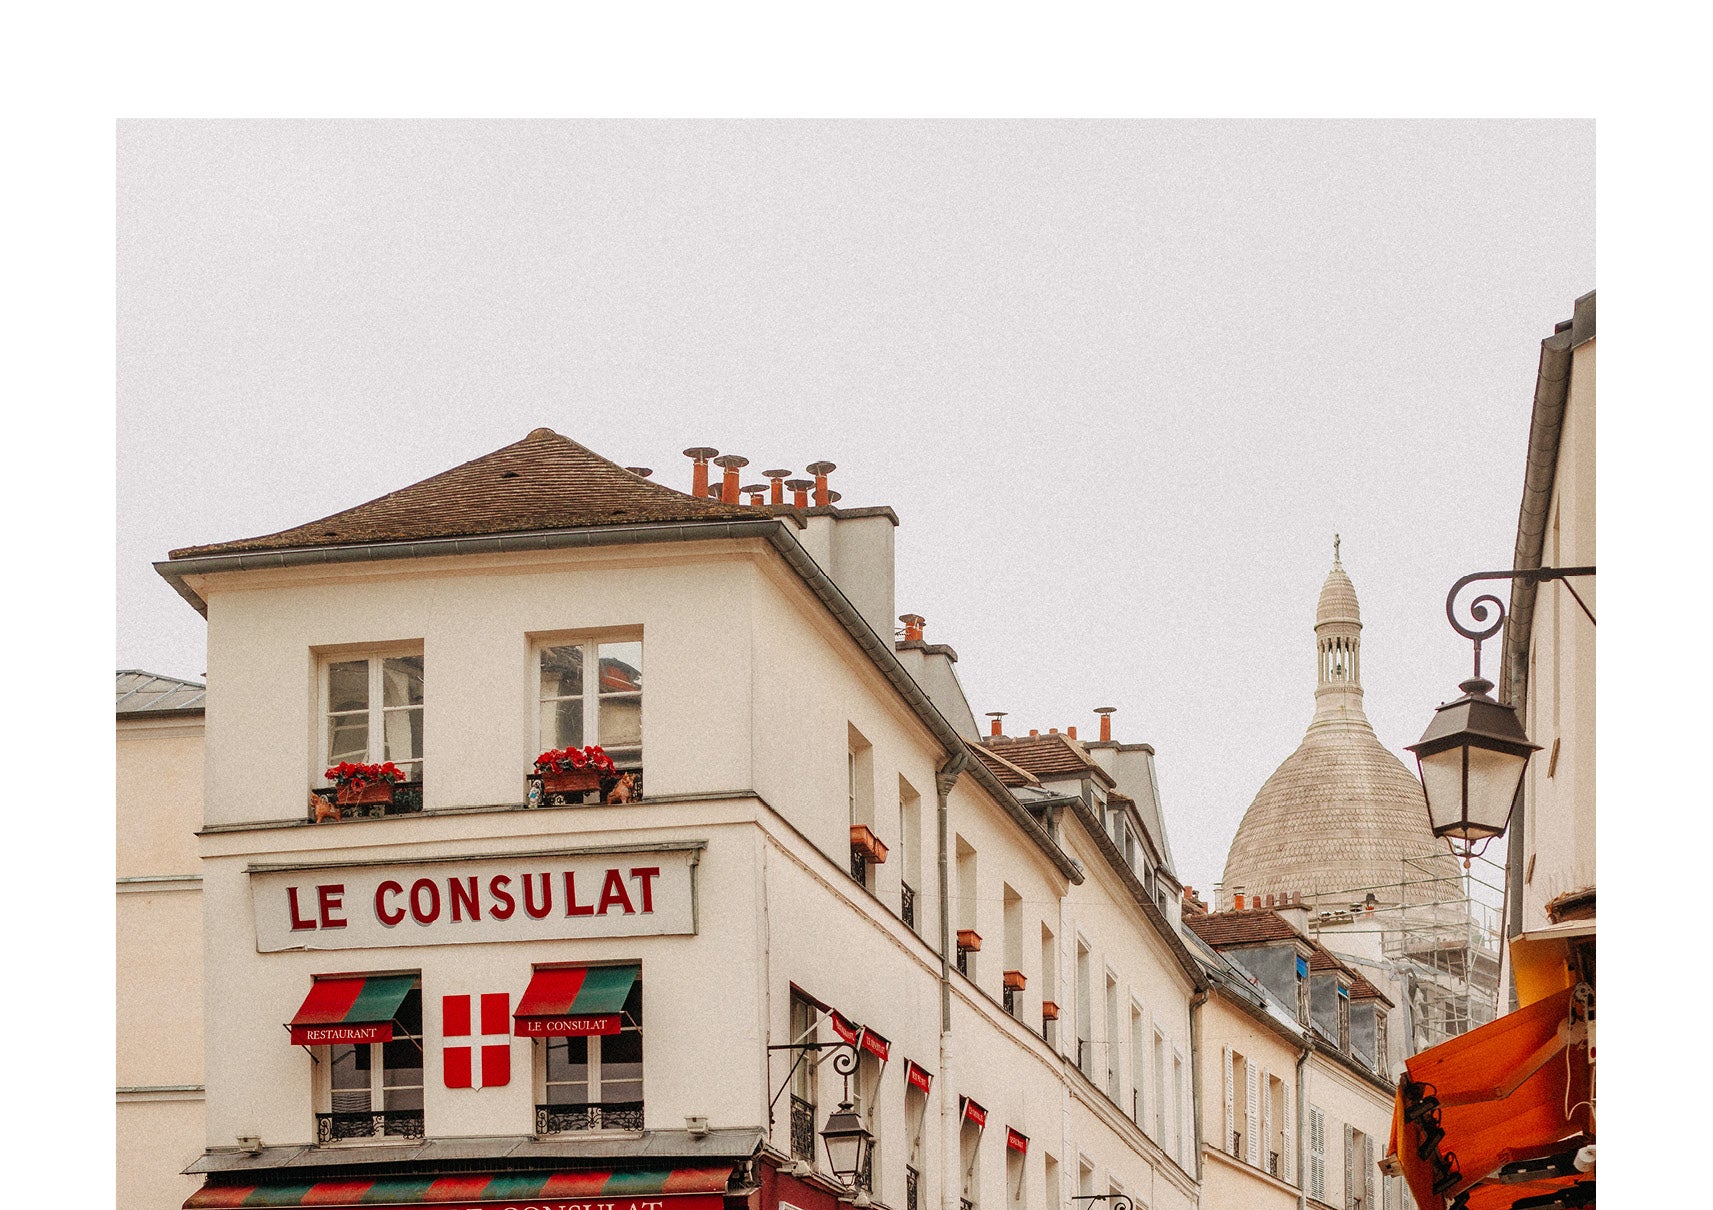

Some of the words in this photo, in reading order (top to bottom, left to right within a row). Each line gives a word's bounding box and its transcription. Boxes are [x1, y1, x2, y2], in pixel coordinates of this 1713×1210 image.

[286, 883, 348, 931] LE
[373, 866, 661, 928] CONSULAT
[527, 1020, 543, 1032] LE
[546, 1018, 608, 1031] CONSULAT
[306, 1027, 377, 1040] RESTAURANT
